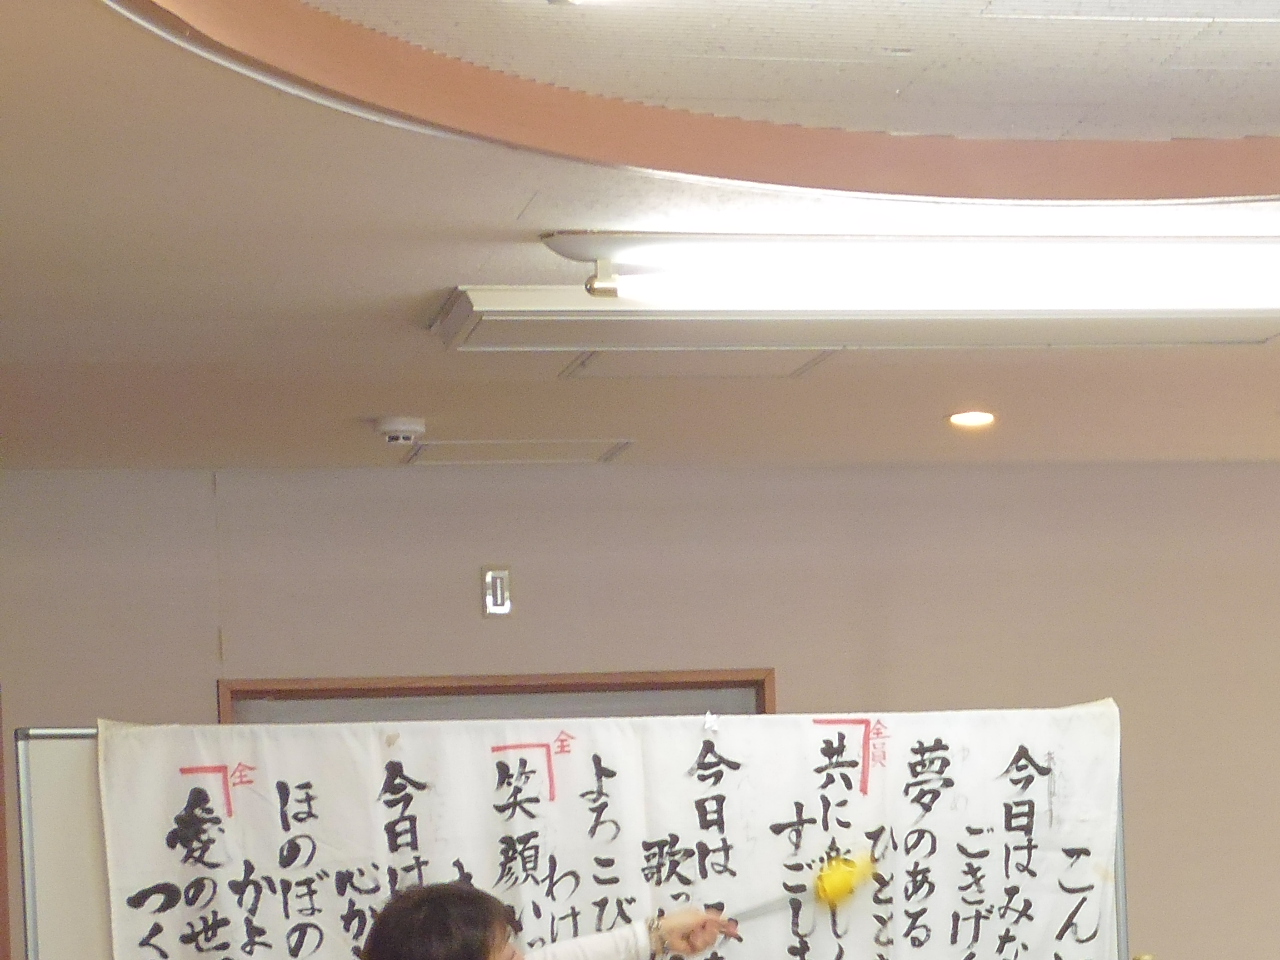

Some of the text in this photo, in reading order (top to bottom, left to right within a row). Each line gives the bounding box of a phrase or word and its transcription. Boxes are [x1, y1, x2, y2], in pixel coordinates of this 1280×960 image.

[553, 730, 576, 755] 全
[869, 719, 891, 767] 全員
[230, 762, 257, 789] 全
[903, 737, 955, 949] 夢のある
